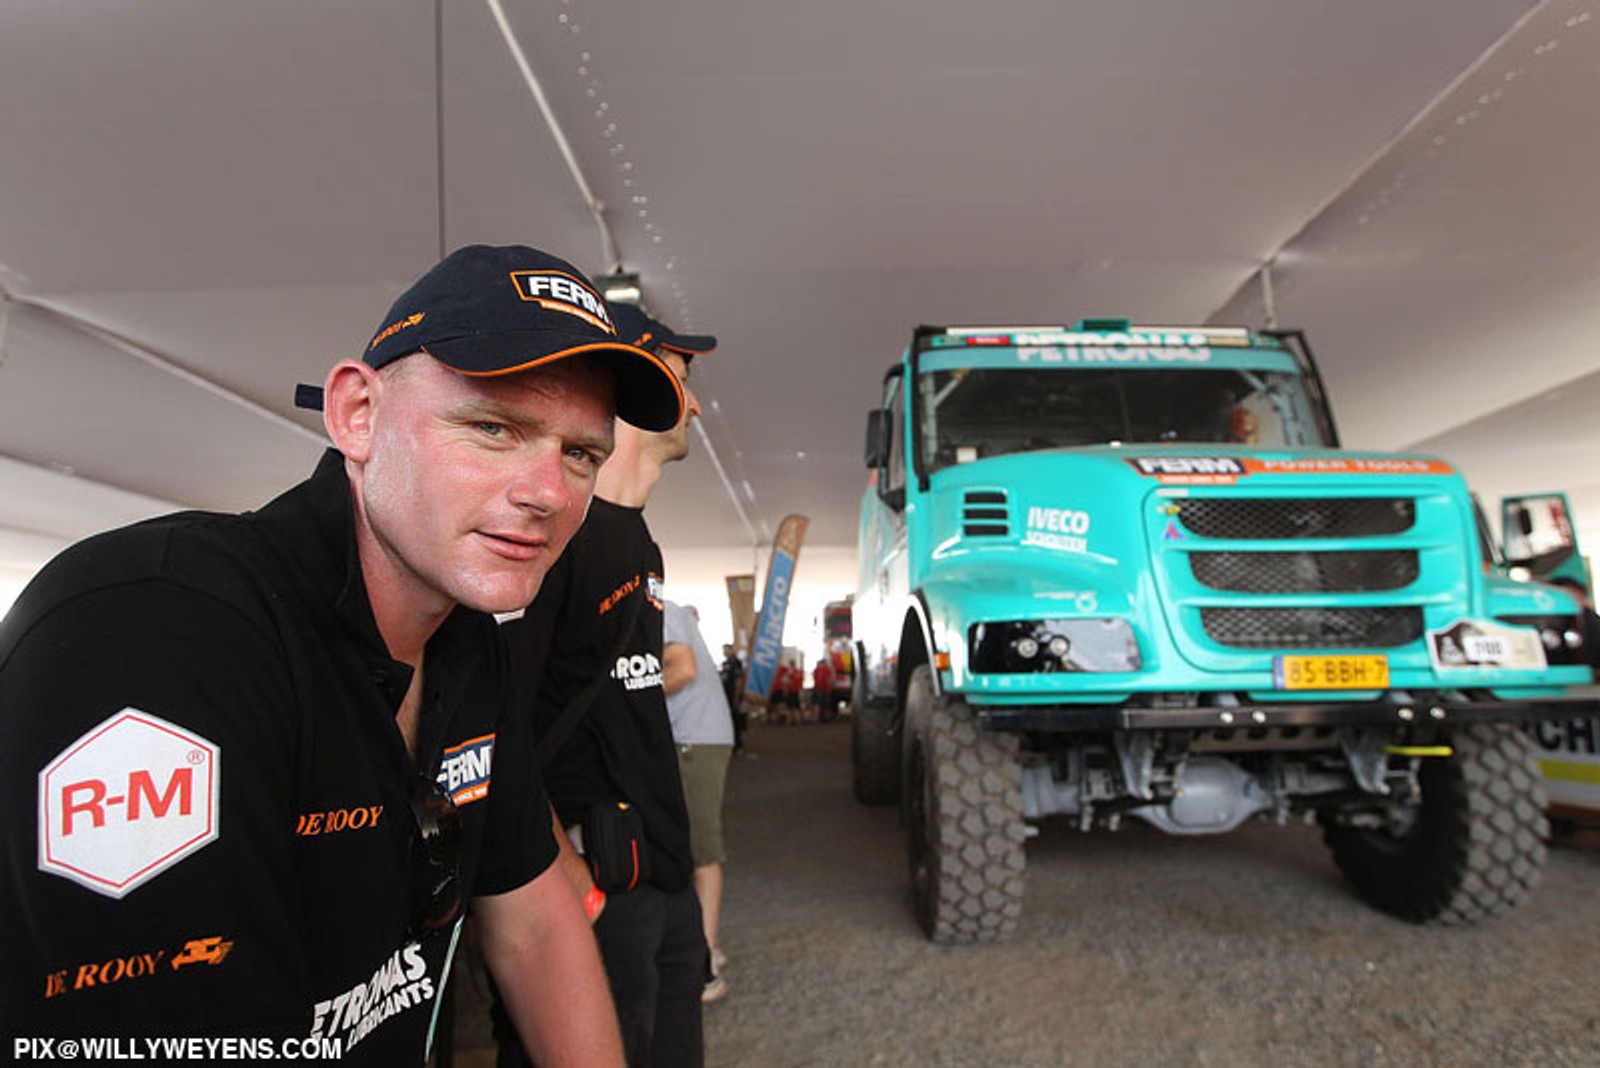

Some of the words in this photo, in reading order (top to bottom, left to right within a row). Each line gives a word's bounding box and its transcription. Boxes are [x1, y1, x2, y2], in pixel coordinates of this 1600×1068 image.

[528, 276, 610, 324] FERM
[1016, 333, 1211, 362] PETRONAS
[1137, 457, 1241, 473] FERM
[1027, 507, 1089, 535] IVECO
[62, 767, 193, 838] R-M
[324, 805, 384, 834] ROOY
[74, 950, 165, 991] ROOY
[310, 944, 427, 1042] ETRONAS
